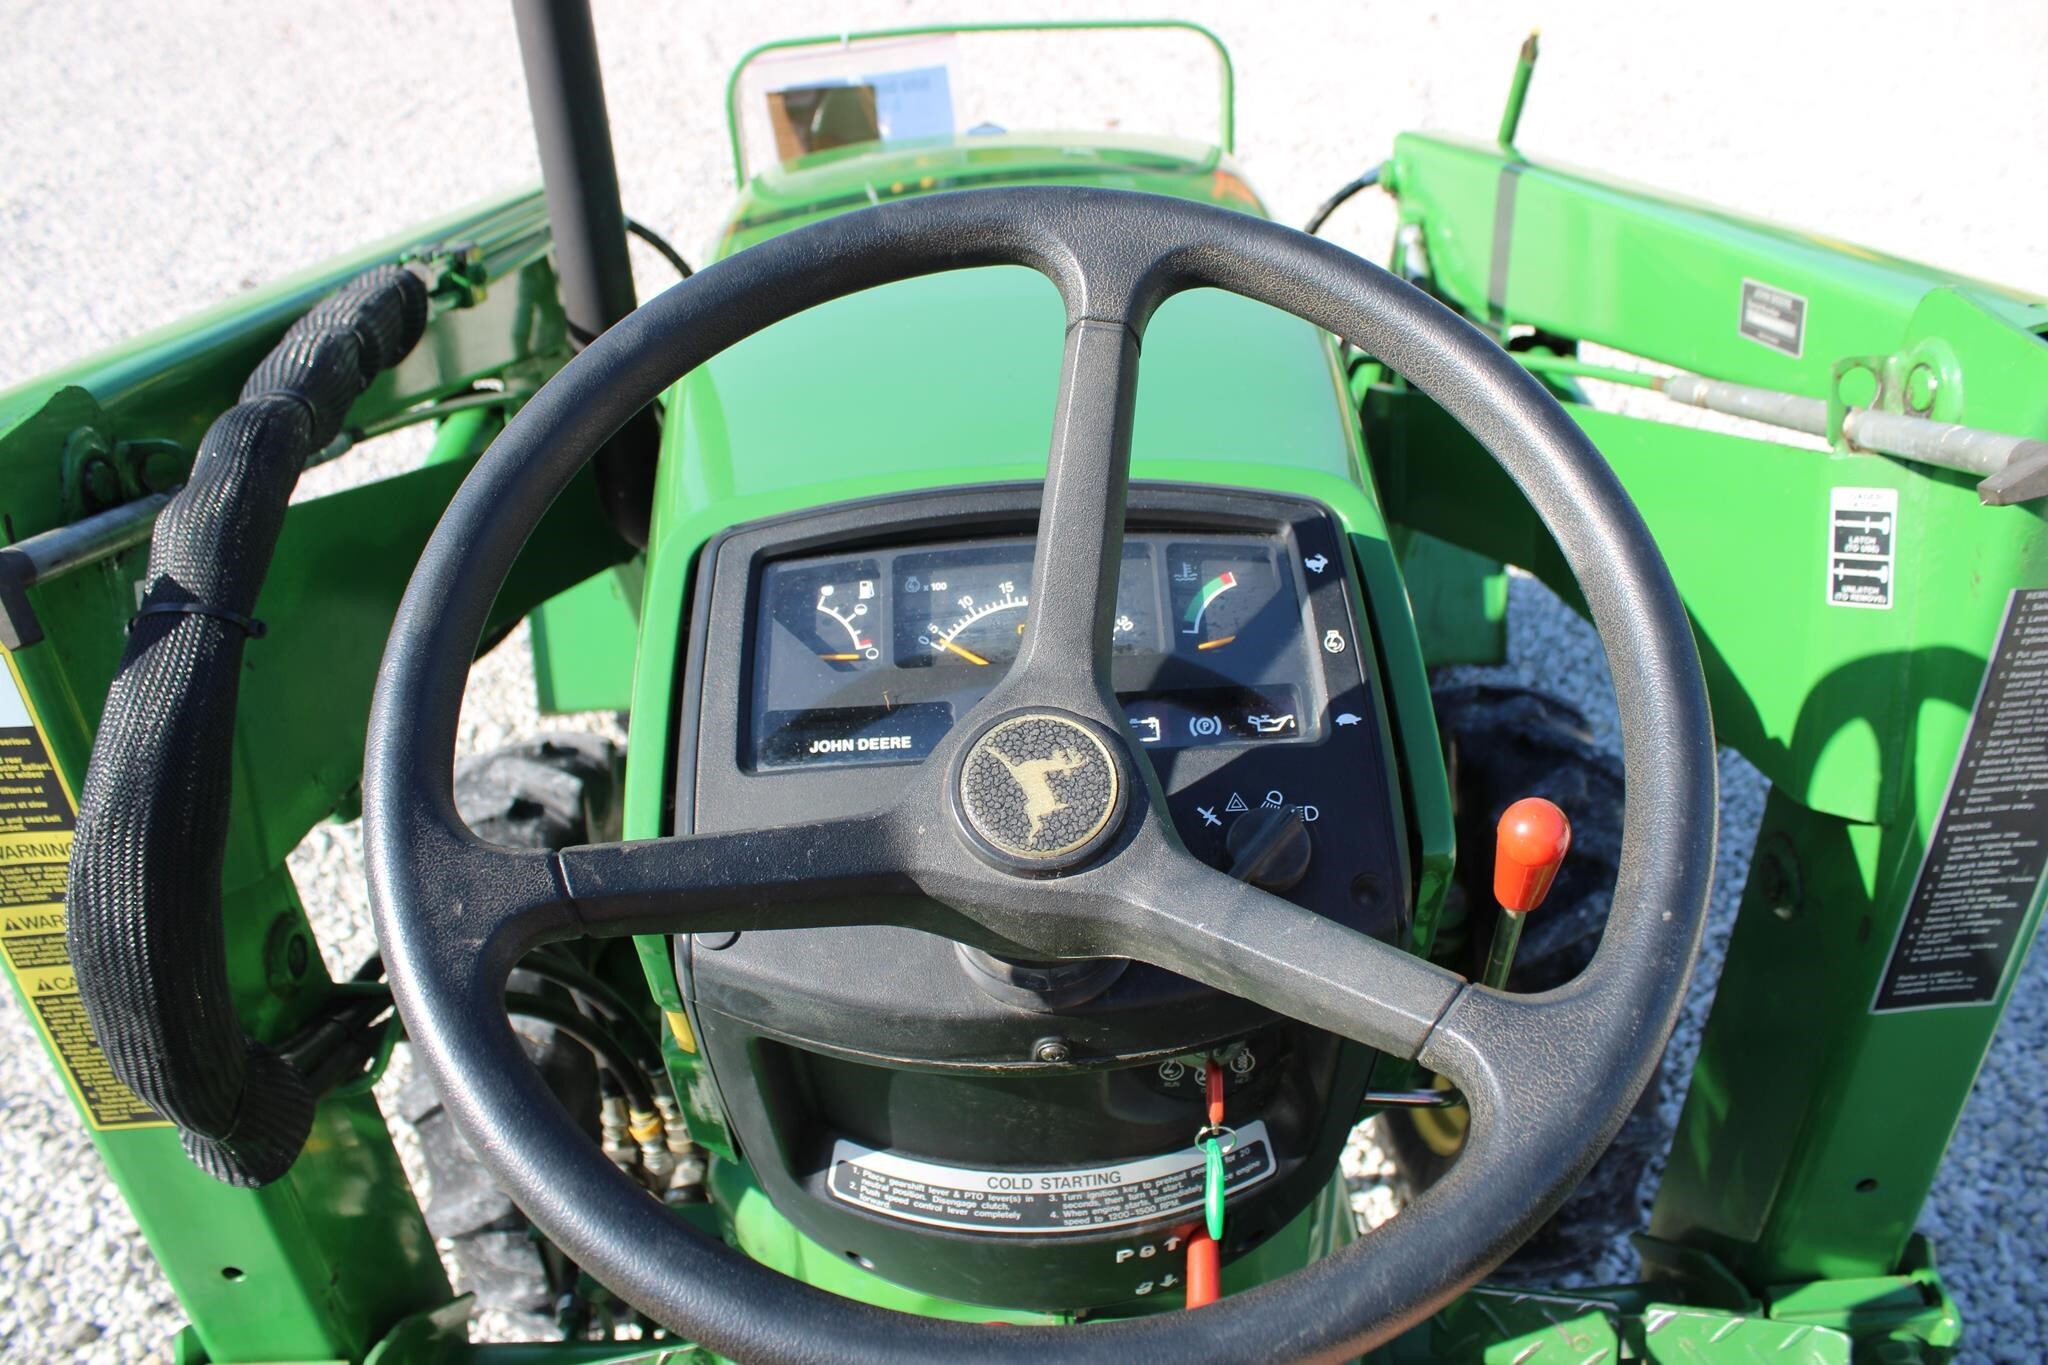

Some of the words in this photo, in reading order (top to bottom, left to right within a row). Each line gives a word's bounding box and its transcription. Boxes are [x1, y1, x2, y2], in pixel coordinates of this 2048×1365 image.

[1848, 536, 1876, 544] LATCH
[931, 582, 947, 591] 100
[998, 581, 1014, 594] 15
[1841, 585, 1880, 594] UNLATCH
[958, 594, 974, 609] 10
[928, 623, 940, 634] 5
[1116, 614, 1134, 632] 30
[918, 636, 930, 645] 0
[809, 738, 854, 754] JOHN
[858, 736, 912, 750] DEERE
[987, 1176, 1032, 1190] COLD
[1040, 1171, 1121, 1189] STARTING
[1049, 1194, 1058, 1202] 3.
[1062, 1192, 1082, 1201] Turn
[1087, 1188, 1118, 1200] ignition
[1123, 1184, 1138, 1194] key
[1143, 1181, 1152, 1189] to
[1156, 1172, 1187, 1188] preheat
[1224, 1154, 1236, 1163] for
[1240, 1148, 1250, 1157] 20
[852, 1166, 860, 1174] 1.
[862, 1169, 886, 1183] Place
[889, 1178, 925, 1192] gearshift
[928, 1186, 950, 1197] lever
[953, 1190, 960, 1198] &
[964, 1192, 984, 1200] PTO
[988, 1194, 1022, 1204] lever(s)
[861, 1178, 889, 1192] neutral
[893, 1188, 927, 1201] position.
[932, 1196, 977, 1210] Disengage
[981, 1202, 1010, 1210] clutch.
[1050, 1210, 1059, 1219] 4.
[1063, 1208, 1087, 1218] When
[1091, 1204, 1122, 1215] engine
[1154, 1184, 1203, 1203] immediately
[1236, 1160, 1262, 1177] engine
[1104, 1196, 1124, 1206] then
[1128, 1192, 1146, 1201] turn
[1150, 1188, 1159, 1196] to
[1163, 1182, 1185, 1194] start.
[850, 1182, 858, 1190] 2.
[860, 1186, 880, 1198] Push
[884, 1194, 909, 1206] speed
[914, 1201, 942, 1212] control
[947, 1207, 968, 1216] lever
[974, 1210, 1021, 1220] completely
[859, 1193, 892, 1210] forward.
[1063, 1216, 1090, 1226] speed
[1108, 1204, 1157, 1220] 1200-1500
[1160, 1198, 1181, 1210] RPM.
[1116, 1248, 1135, 1264] P
